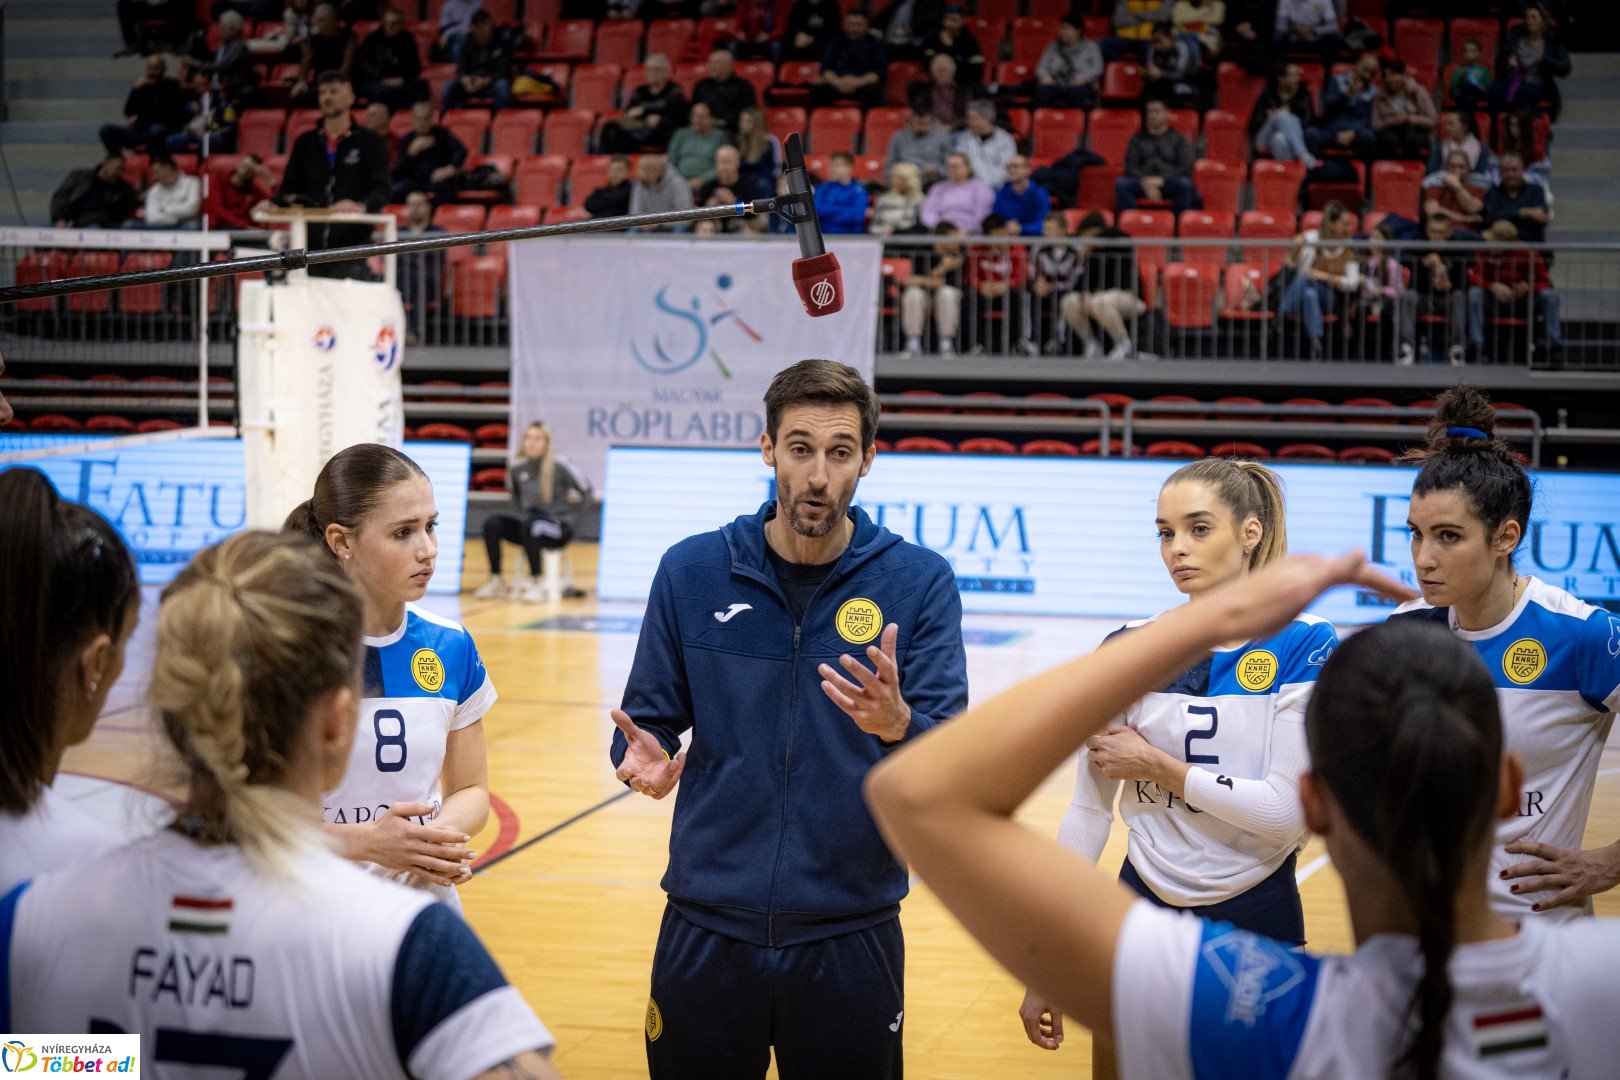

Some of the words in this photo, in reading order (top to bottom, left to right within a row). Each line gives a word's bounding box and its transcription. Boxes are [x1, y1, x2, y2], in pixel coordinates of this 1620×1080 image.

[586, 402, 764, 443] RÖPLABD
[73, 455, 246, 529] FATU
[373, 708, 408, 773] 8
[1184, 704, 1220, 765] 2
[129, 946, 255, 1008] FAYAD
